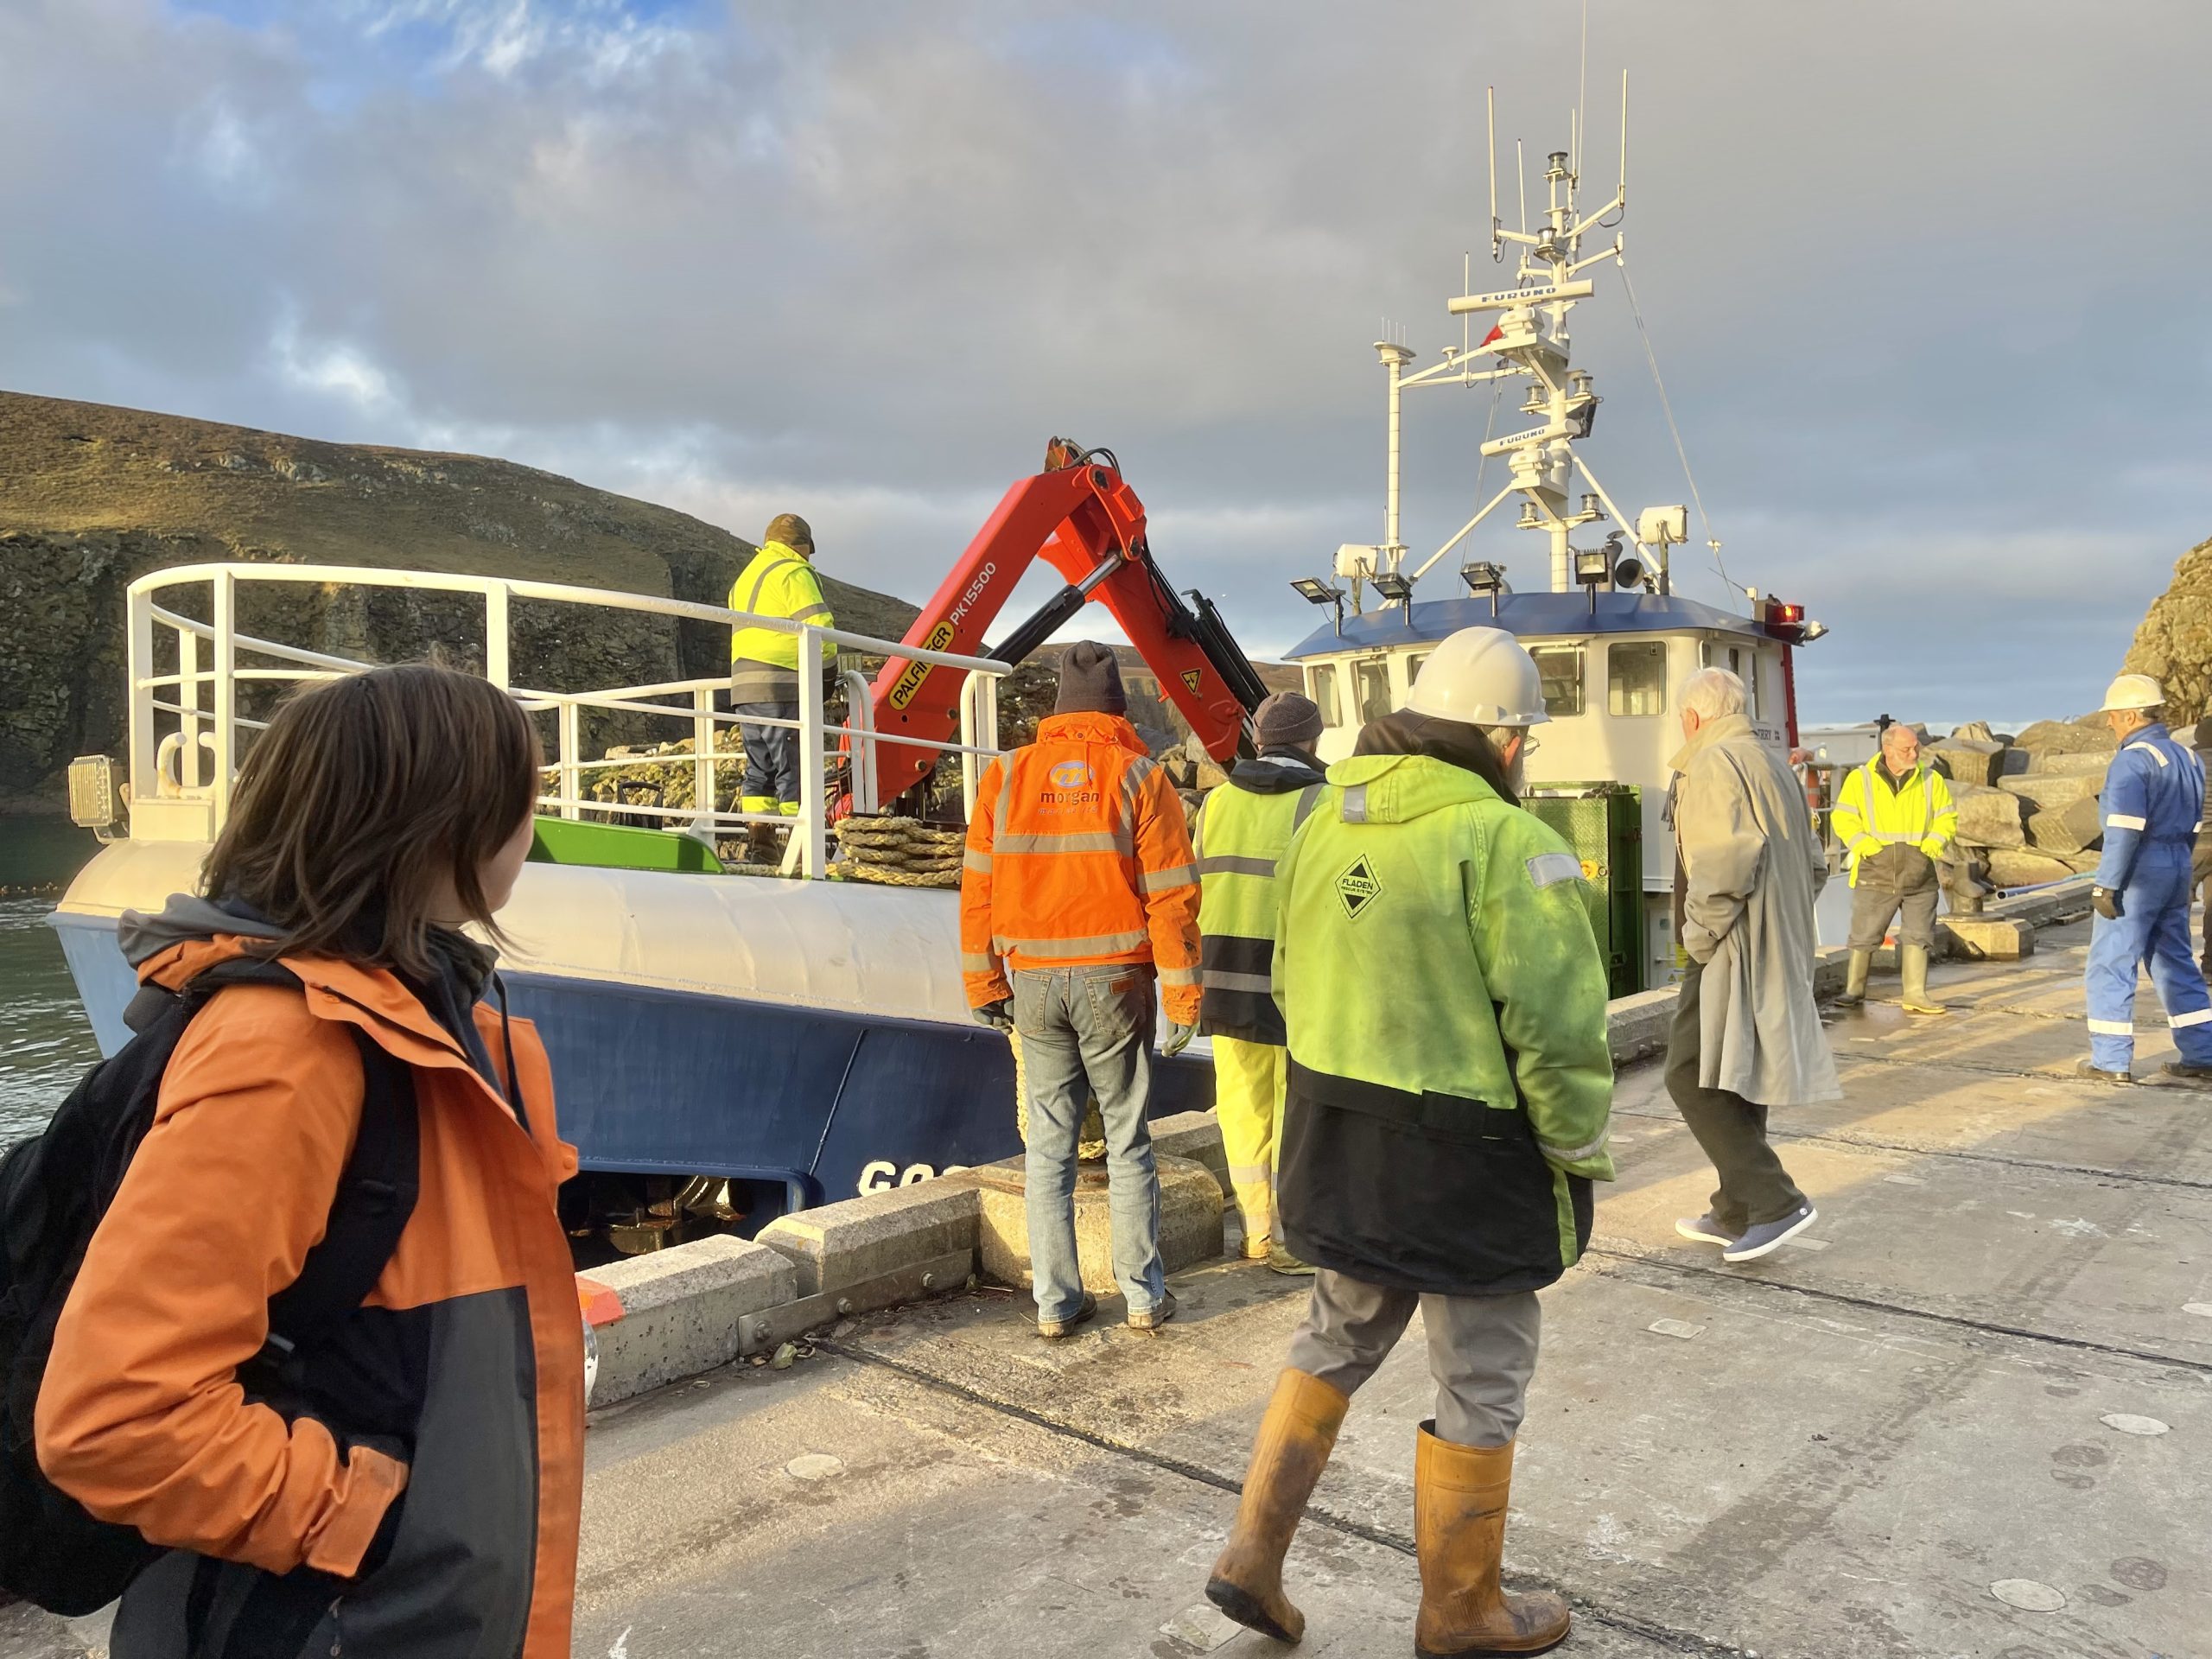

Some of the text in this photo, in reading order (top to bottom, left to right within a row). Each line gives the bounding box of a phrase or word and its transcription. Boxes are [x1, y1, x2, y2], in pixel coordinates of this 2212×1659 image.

[1481, 288, 1556, 302] FURUNO
[1499, 429, 1545, 447] FURUNO
[950, 562, 996, 626] PK15500
[1040, 791, 1100, 806] morgan
[1342, 878, 1374, 891] FLADEN
[857, 1160, 970, 1198] GO
